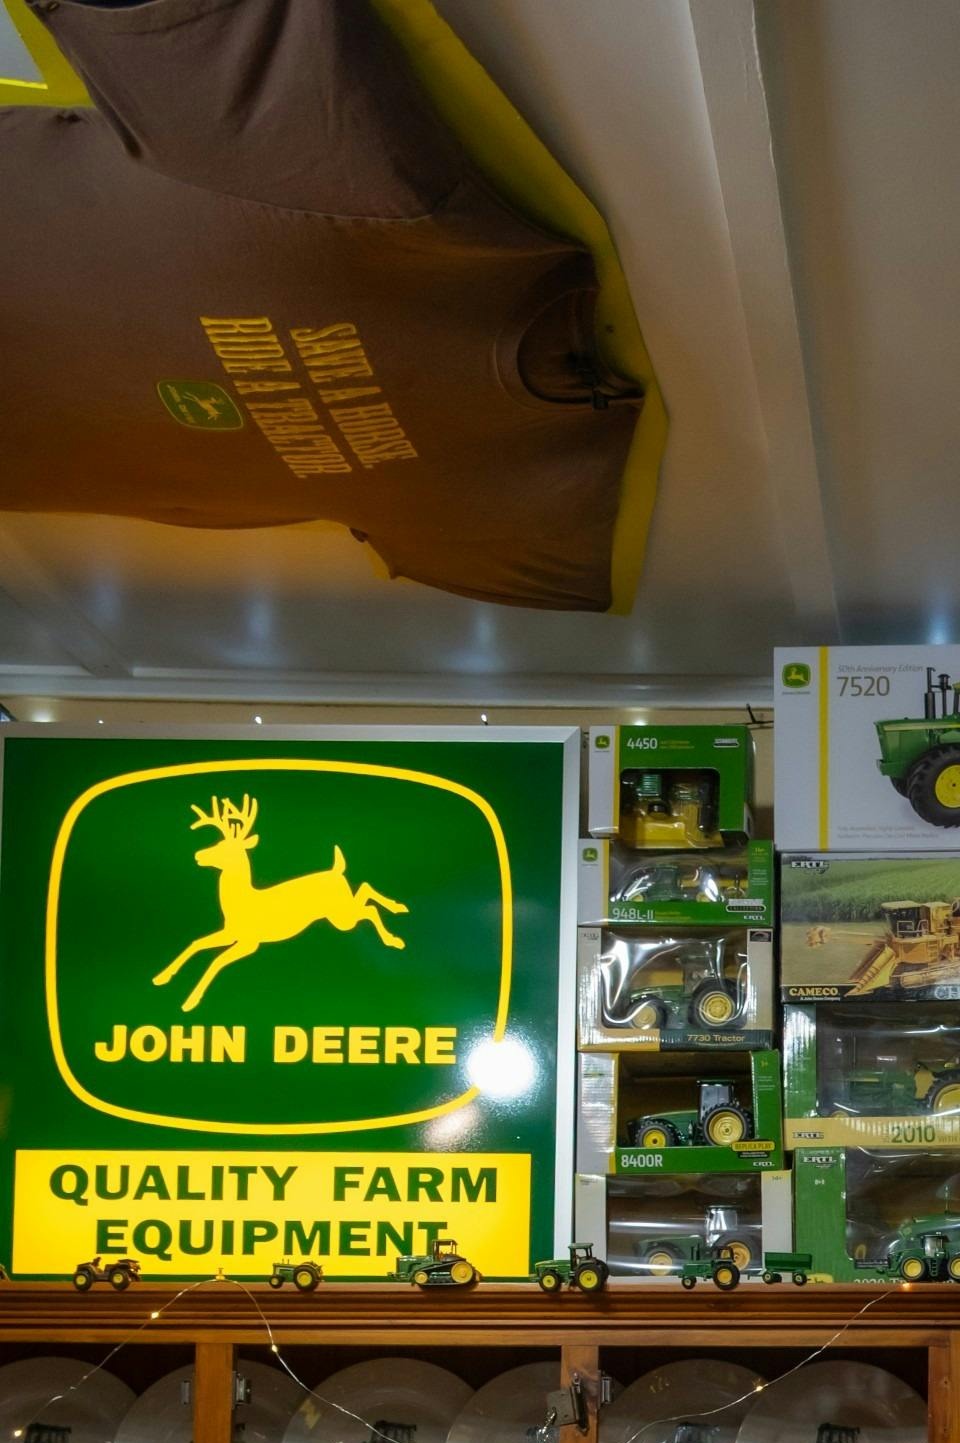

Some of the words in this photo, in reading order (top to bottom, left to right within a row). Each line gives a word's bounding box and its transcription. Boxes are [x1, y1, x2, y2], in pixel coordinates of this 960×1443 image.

[200, 316, 293, 374] RIDE
[289, 323, 374, 383] SAVE
[232, 379, 302, 395] A
[318, 386, 382, 404] A
[899, 663, 924, 672] Edition
[836, 675, 890, 697] 7520
[626, 737, 659, 750] 4450
[791, 860, 829, 870] ERTL
[611, 907, 655, 921] 948L-II
[788, 986, 840, 997] CAMECO
[94, 1024, 246, 1064] JOHN
[273, 1025, 458, 1065] DEERE
[686, 1033, 712, 1042] 7730
[713, 1033, 746, 1042] Tractor
[890, 1125, 936, 1144] 2010
[620, 1153, 664, 1168] 8400R
[802, 1155, 837, 1164] ERTL
[48, 1163, 299, 1207] QUALITY
[333, 1166, 498, 1204] FARM
[97, 1218, 450, 1259] EQUIPMENT
